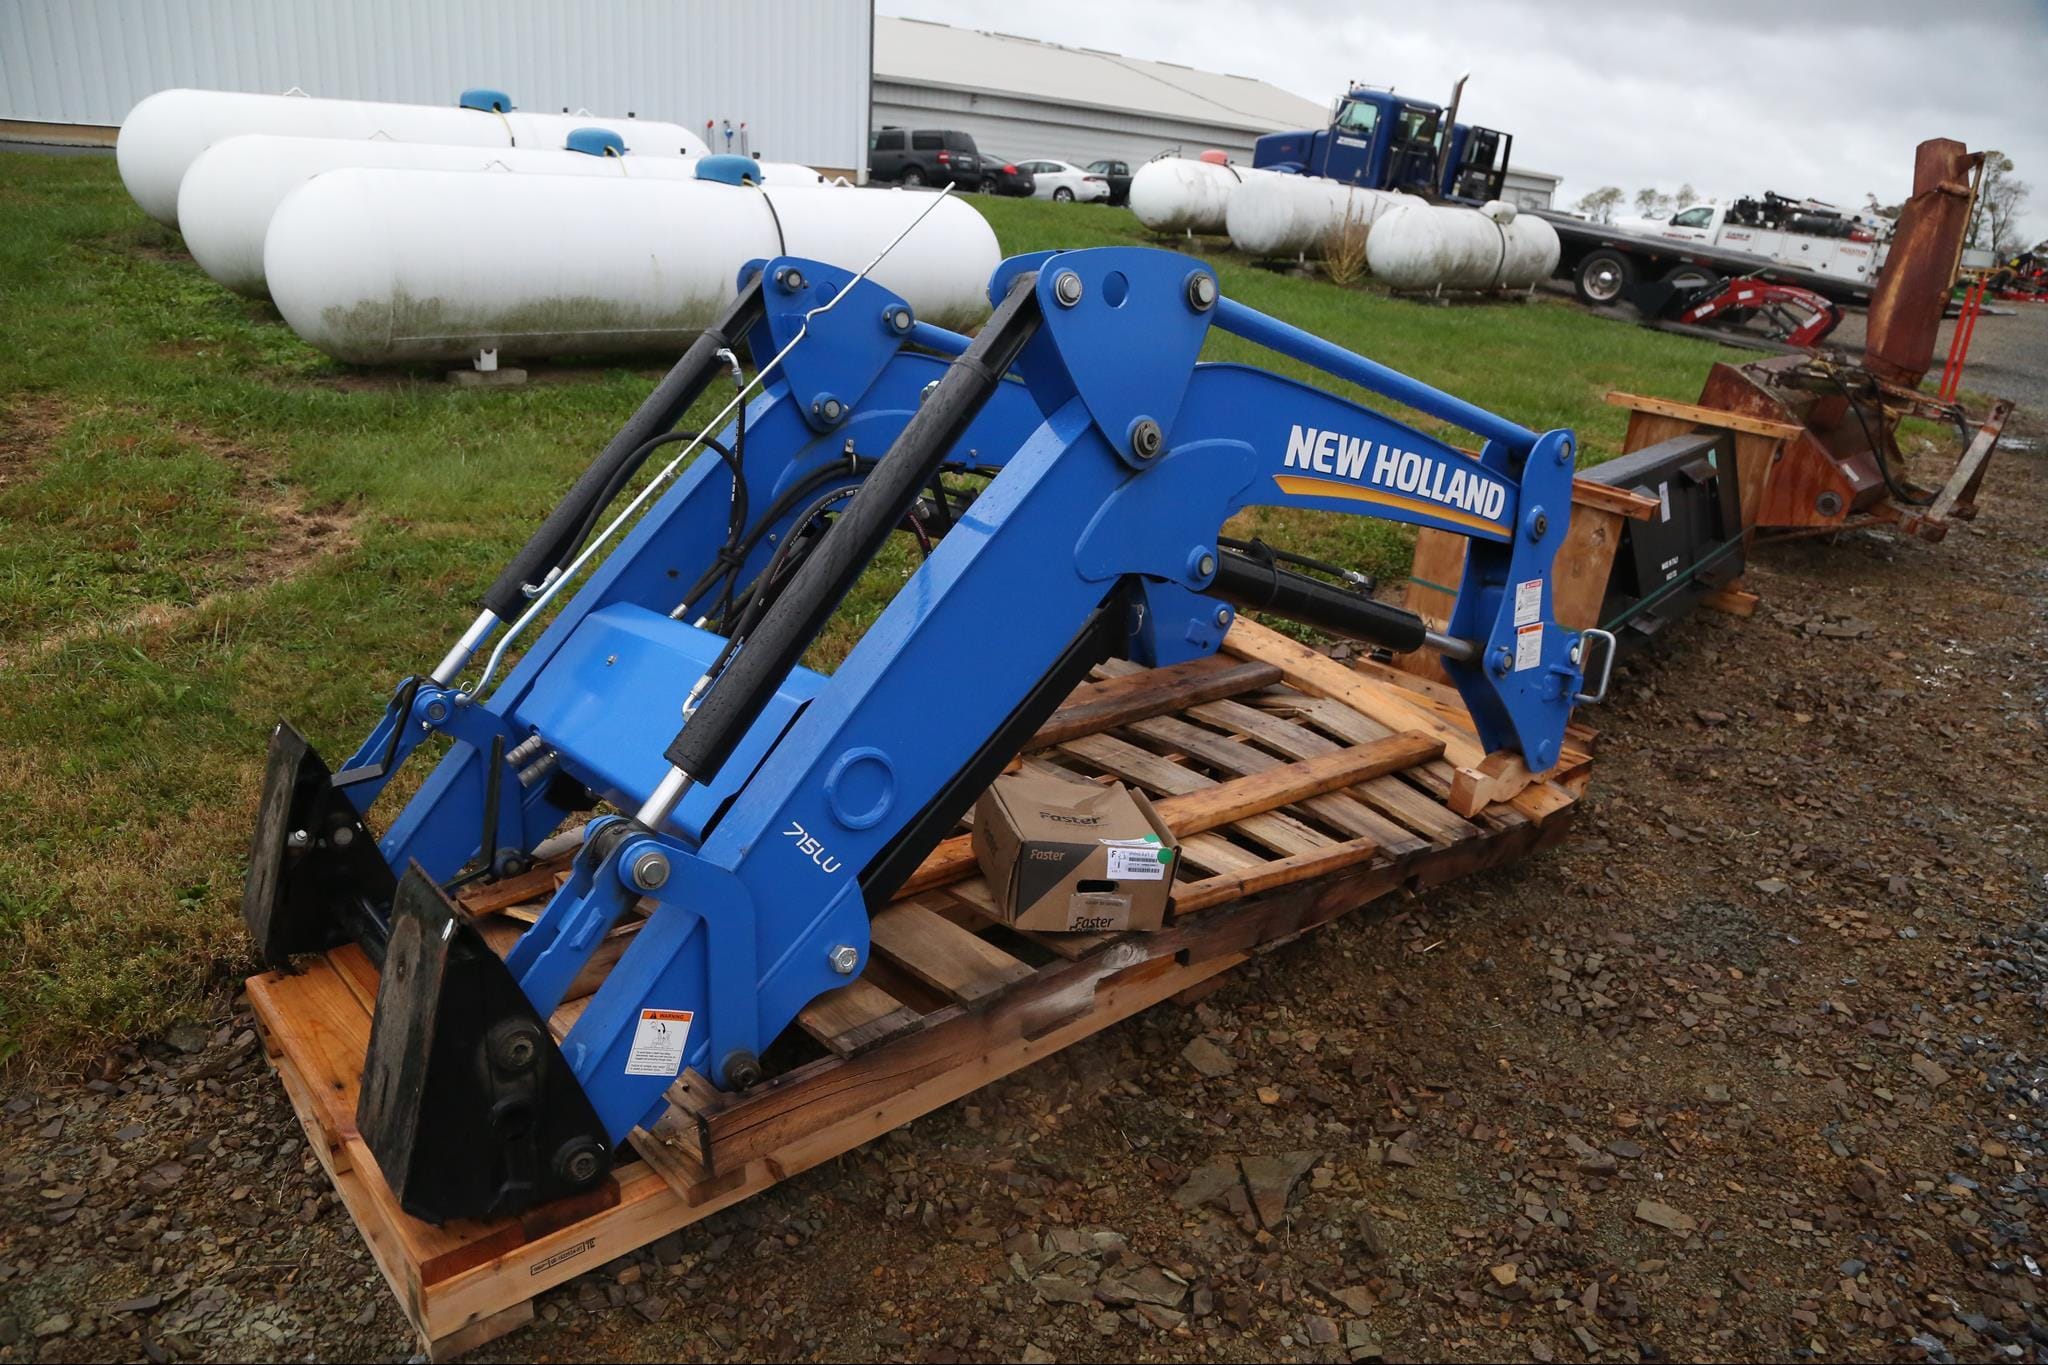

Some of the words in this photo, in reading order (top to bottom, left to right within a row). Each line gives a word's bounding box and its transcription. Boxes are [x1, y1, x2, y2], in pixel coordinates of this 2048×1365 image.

[1283, 424, 1372, 480] NEW
[1371, 443, 1506, 521] HOLLAND
[782, 821, 842, 873] 715LU
[1029, 849, 1065, 861] Faster
[1074, 916, 1114, 929] Faster
